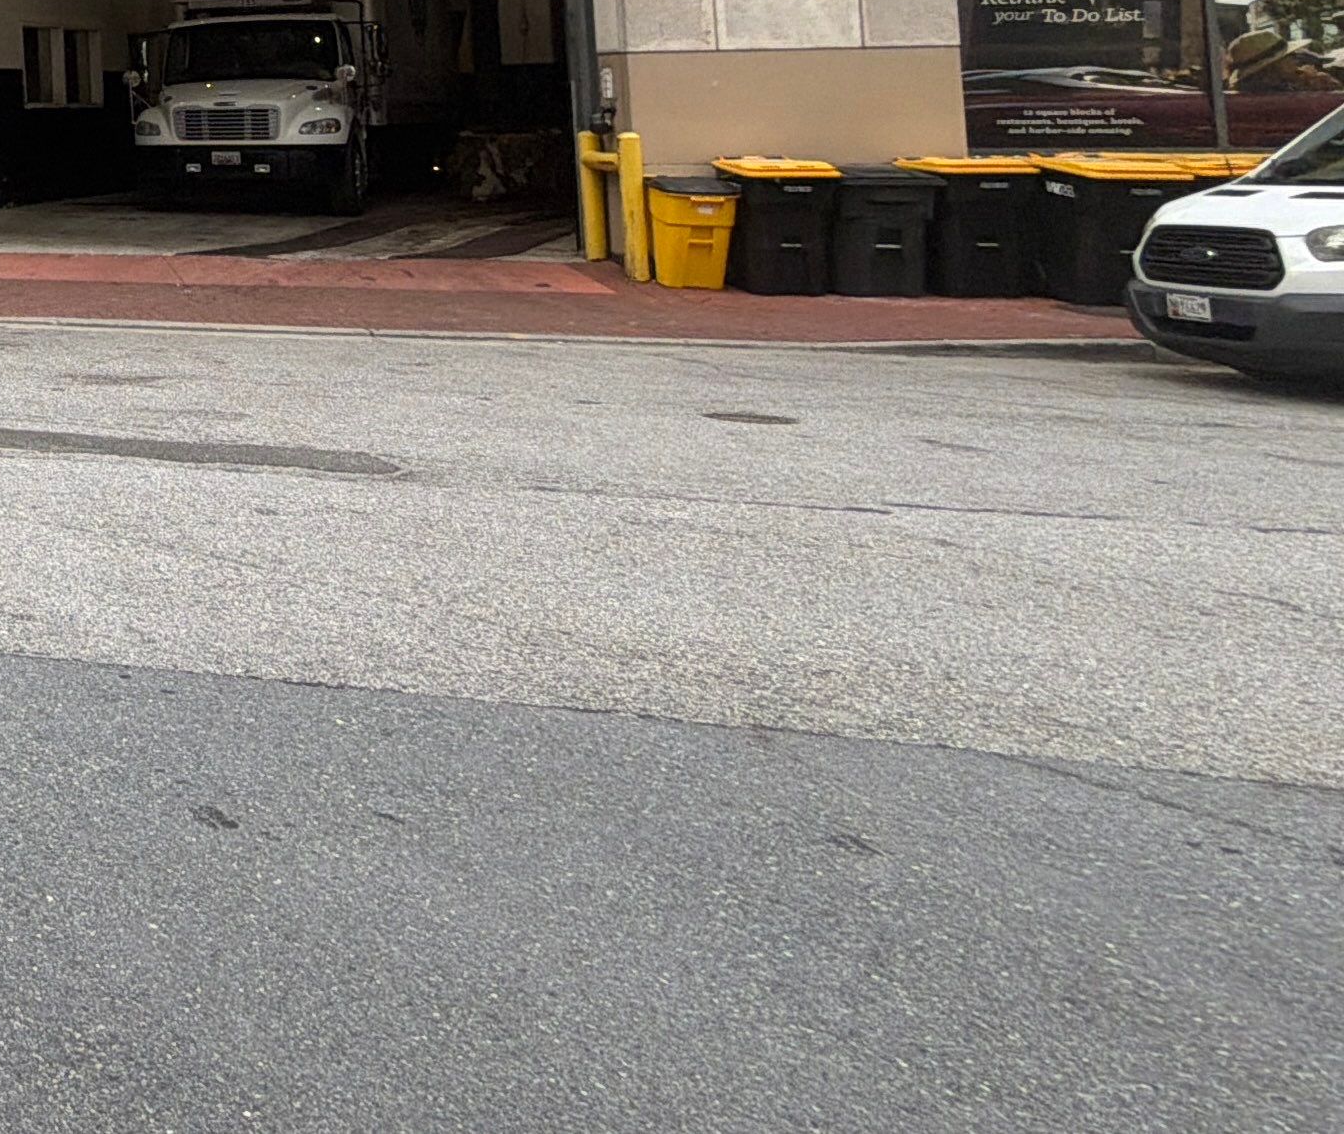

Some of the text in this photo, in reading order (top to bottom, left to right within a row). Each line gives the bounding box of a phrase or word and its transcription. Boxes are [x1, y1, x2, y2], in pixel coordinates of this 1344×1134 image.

[992, 11, 1034, 24] your
[1042, 9, 1067, 23] To
[1071, 8, 1100, 22] Do
